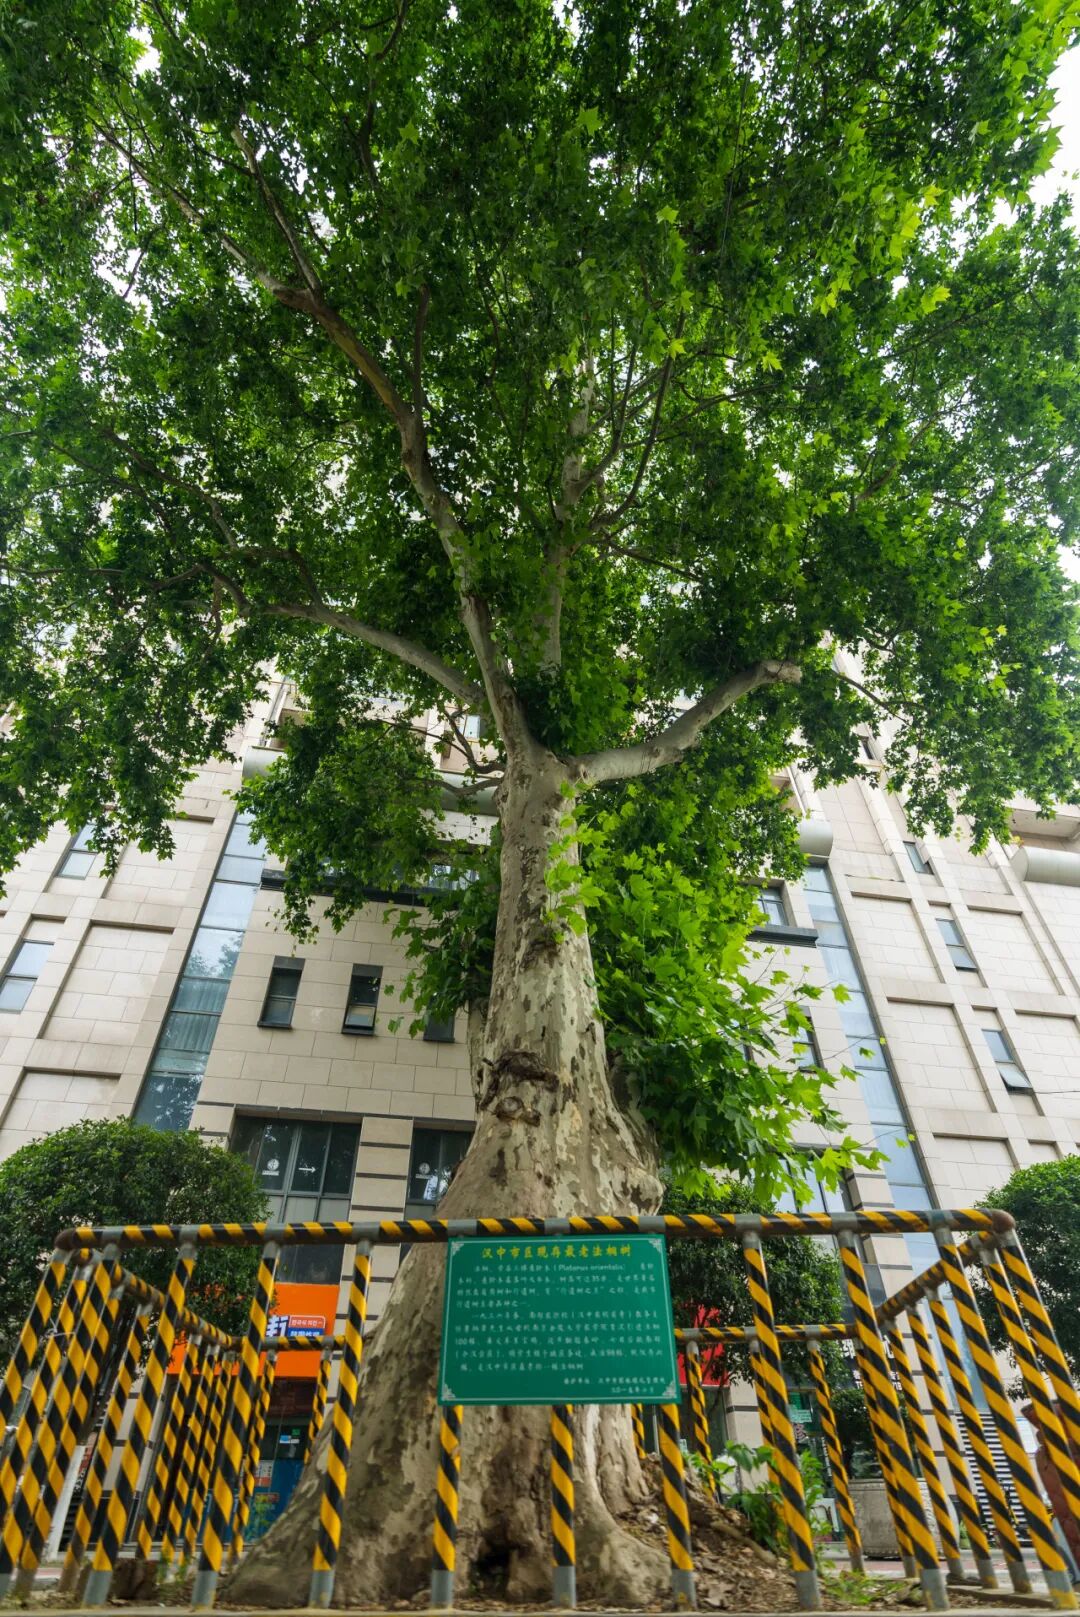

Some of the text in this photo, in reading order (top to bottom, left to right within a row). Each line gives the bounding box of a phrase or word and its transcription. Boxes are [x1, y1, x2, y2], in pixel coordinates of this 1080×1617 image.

[482, 1244, 631, 1260] 汉中市区现存最老法桐树
